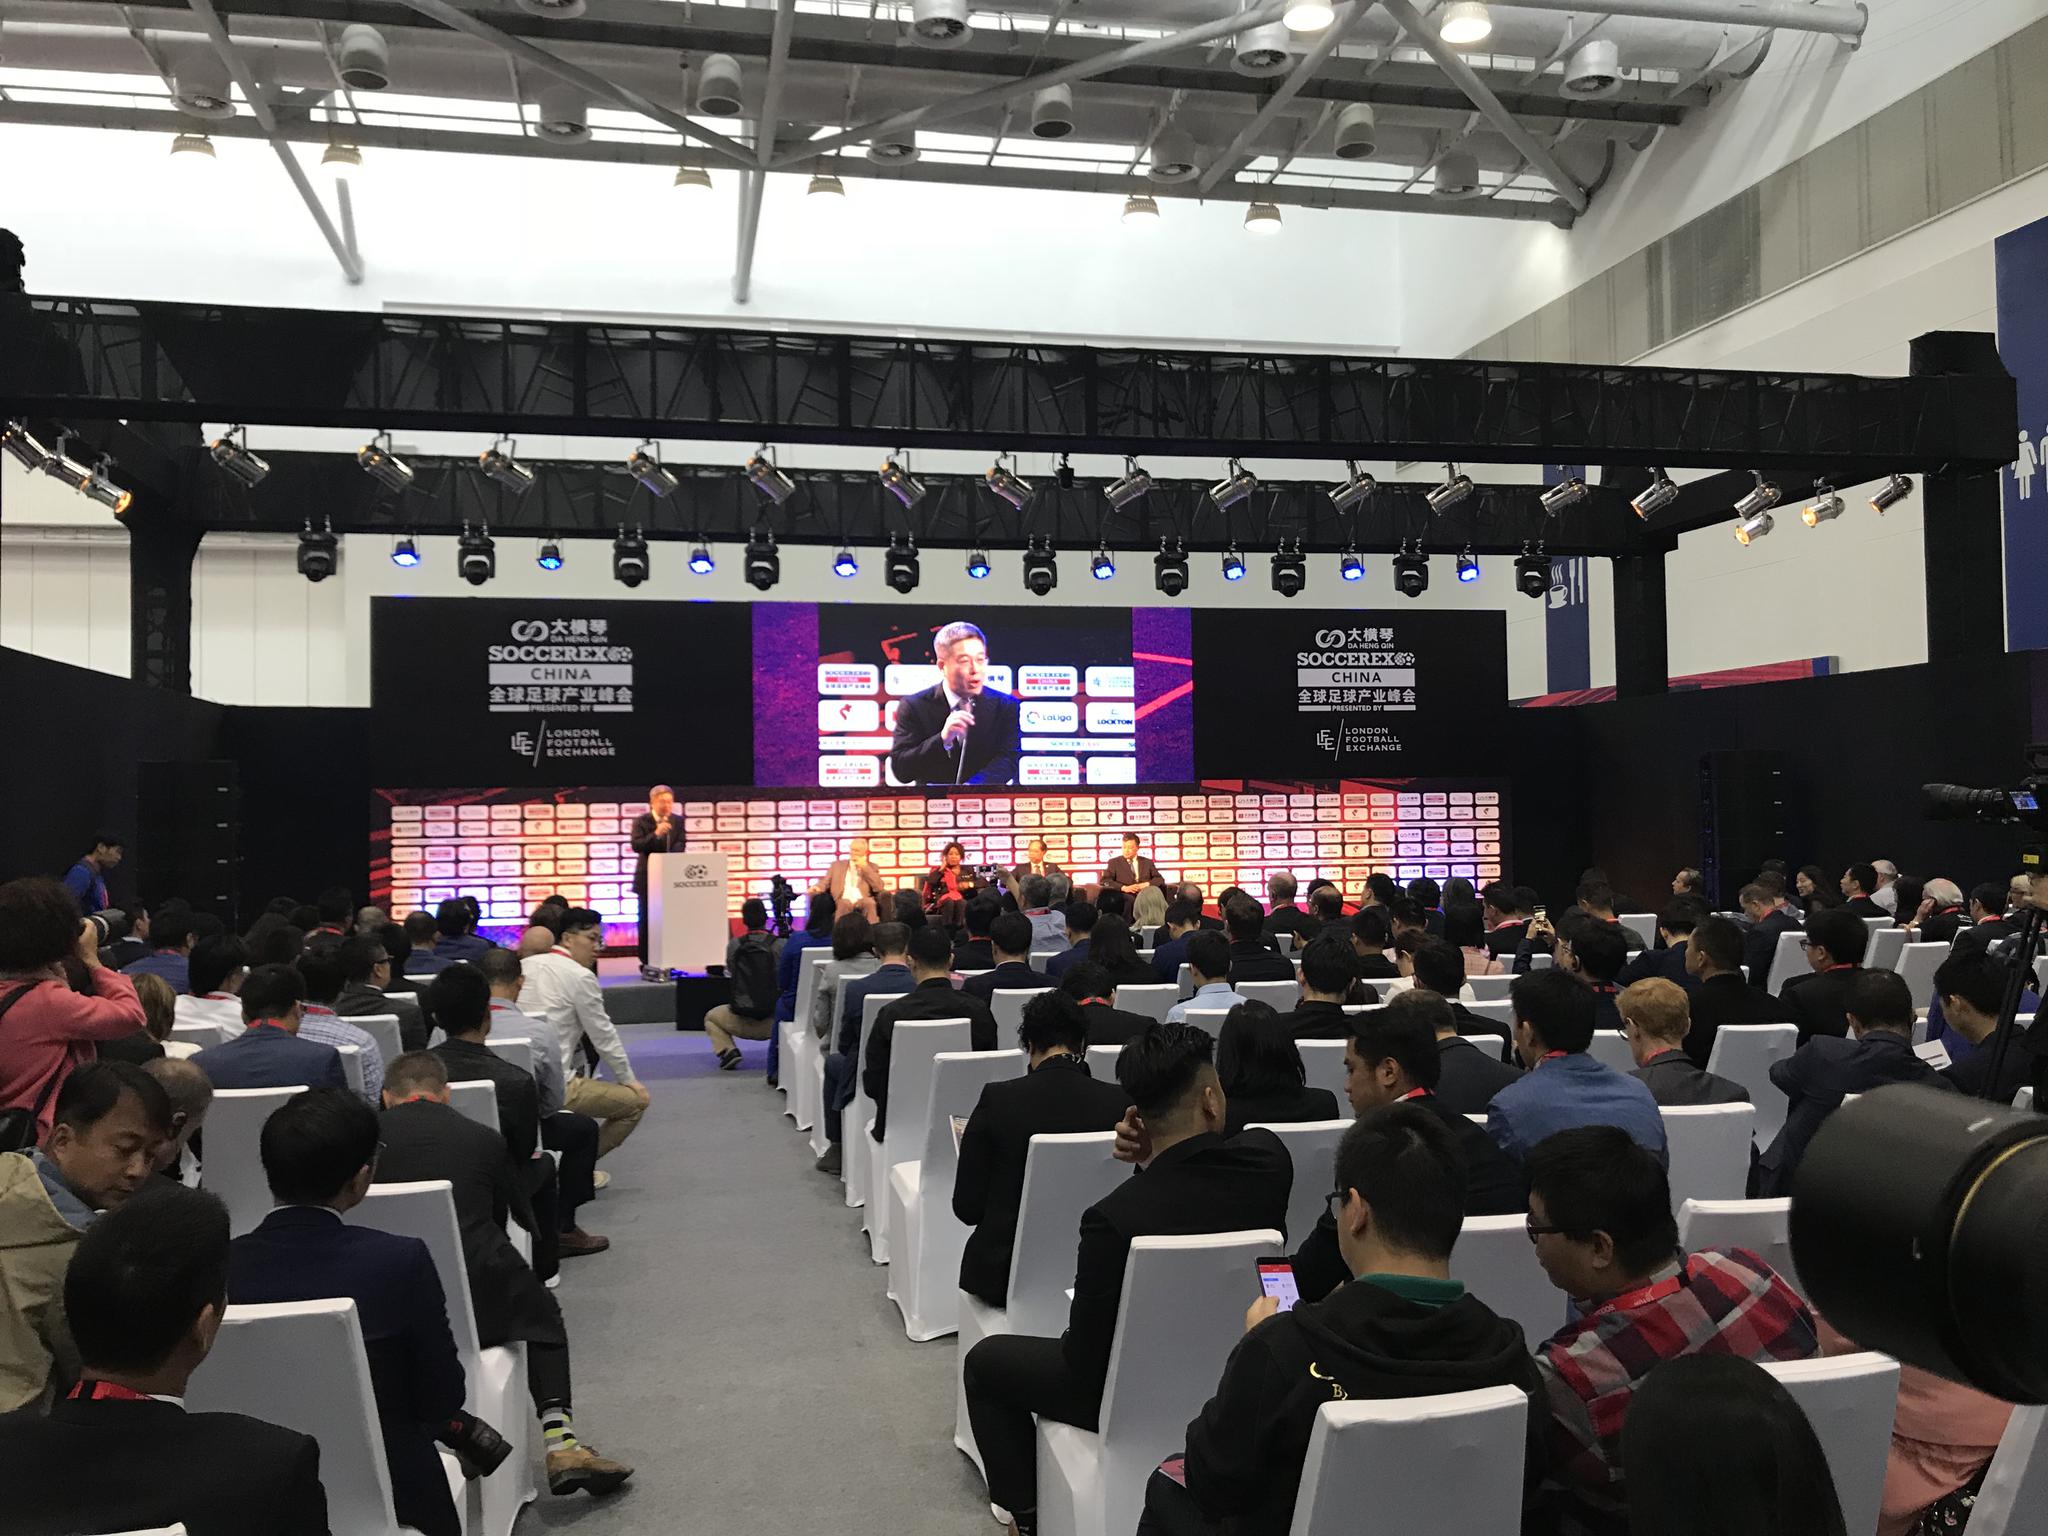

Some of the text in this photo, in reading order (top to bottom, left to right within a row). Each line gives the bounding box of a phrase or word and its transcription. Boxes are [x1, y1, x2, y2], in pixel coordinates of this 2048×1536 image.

[1347, 627, 1394, 642] 大横琴
[488, 644, 609, 662] SOCCEREX
[1297, 652, 1396, 666] SOCCEREX
[530, 667, 592, 680] CHINA
[1331, 671, 1383, 683] CHINA
[489, 686, 633, 703] 全球足球产业峰会
[1298, 689, 1416, 703] 全球足球产业峰会
[529, 704, 592, 712] PRESENTED BY
[546, 728, 601, 738] LONDON
[1345, 727, 1389, 735] LONDON
[546, 738, 613, 747] FOOTBALL
[1345, 735, 1400, 743] FOOTBALL
[546, 747, 617, 757] EXCHANGE
[1345, 744, 1403, 752] EXCHANGE
